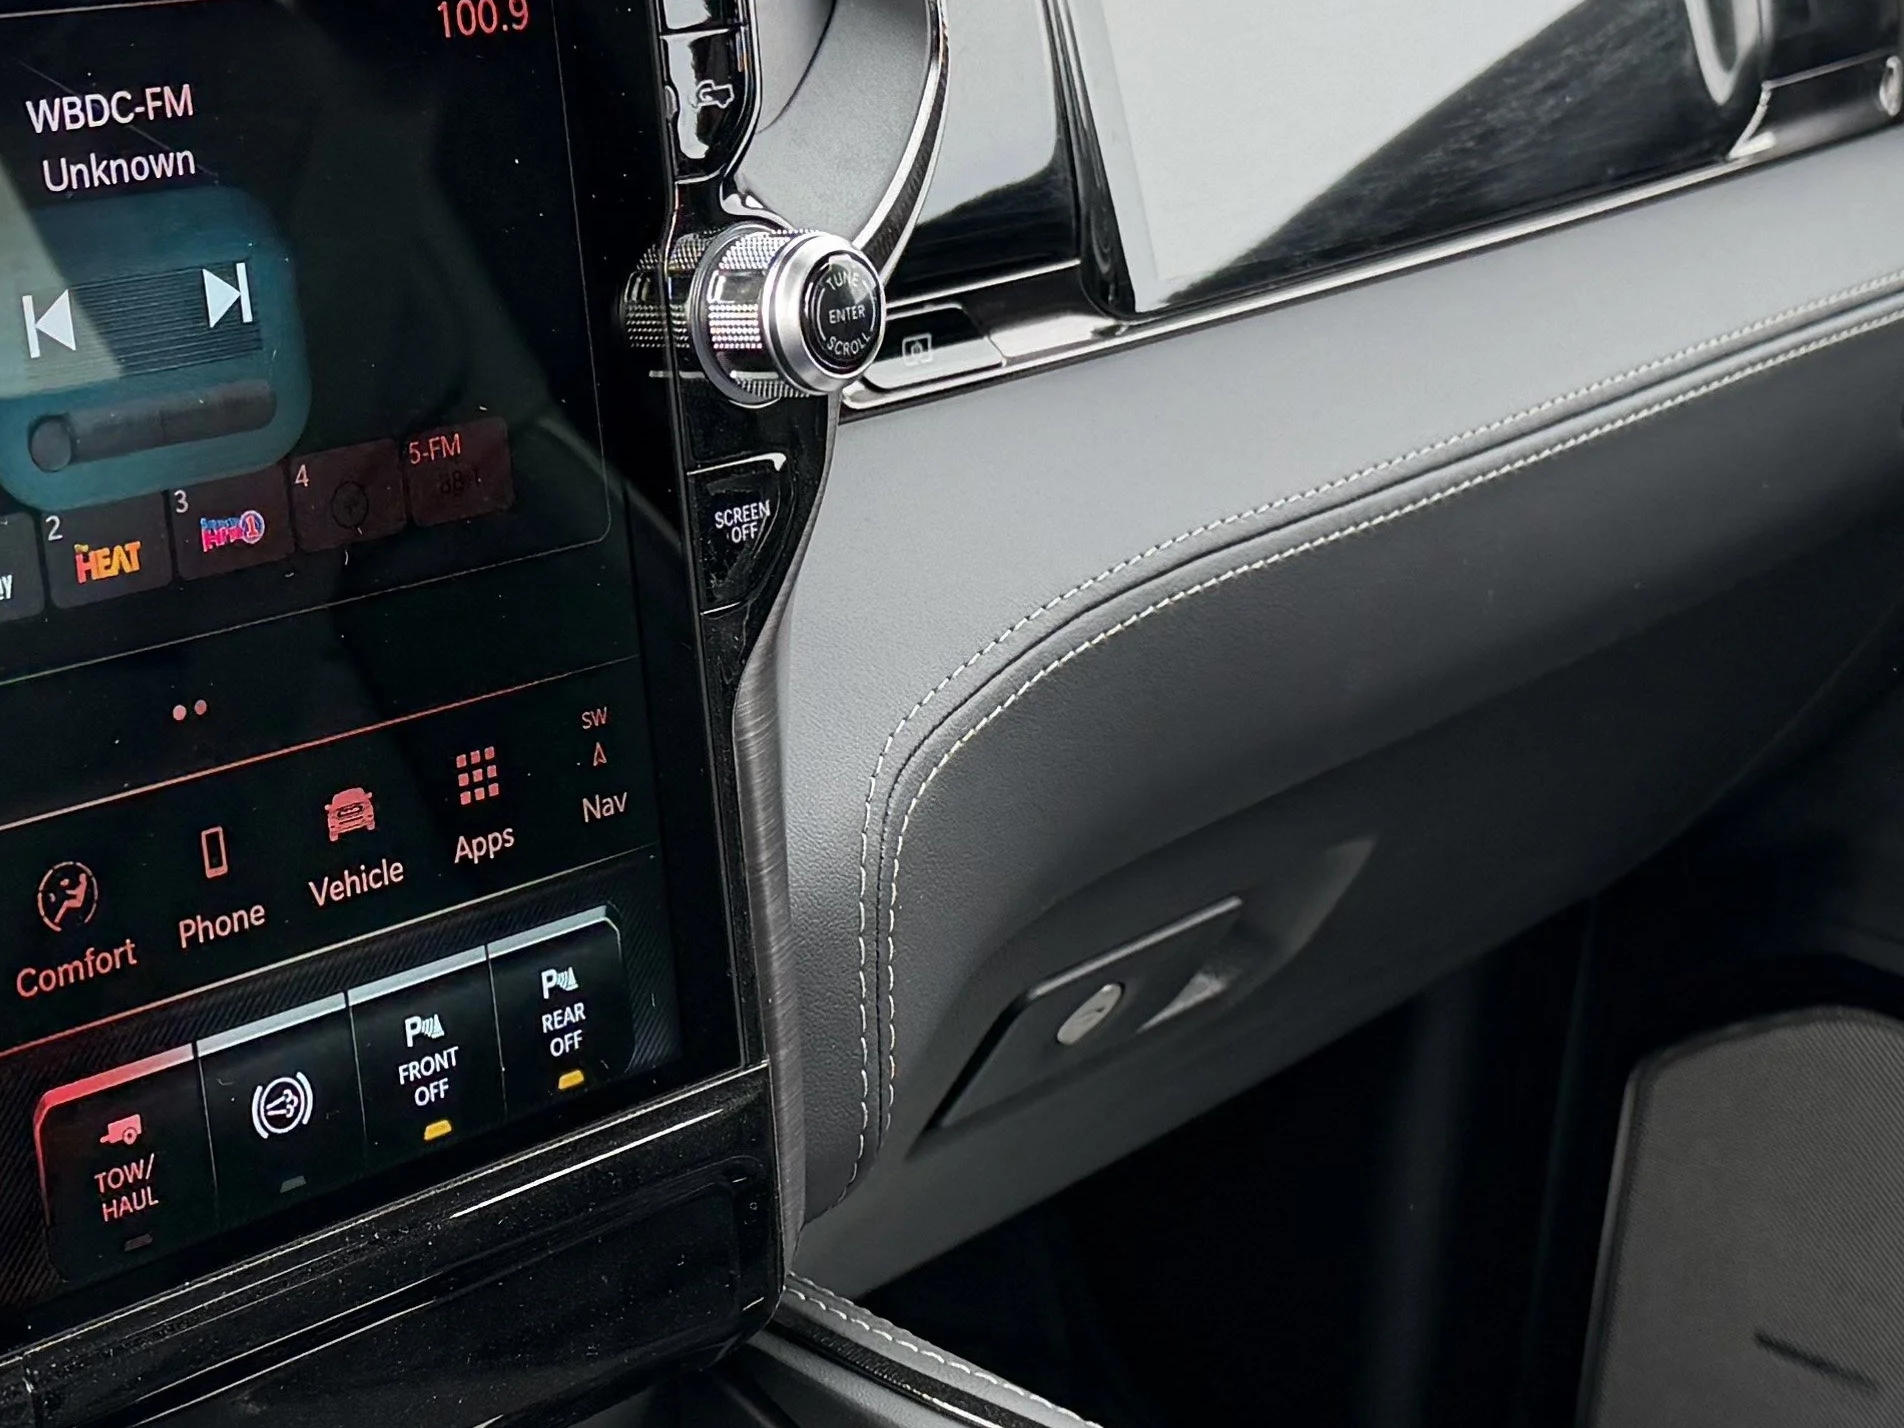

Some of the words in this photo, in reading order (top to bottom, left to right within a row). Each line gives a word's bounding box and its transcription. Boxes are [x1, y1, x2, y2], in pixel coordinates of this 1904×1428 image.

[25, 83, 195, 135] WBDC-FM
[41, 148, 197, 193] Unknown
[826, 272, 861, 291] TUNE
[828, 305, 867, 325] ENTER
[826, 332, 873, 359] SCROLL
[407, 432, 463, 465] 5-FM
[294, 464, 310, 487] 4
[174, 489, 190, 514] 3
[714, 499, 772, 529] SCREEN
[45, 515, 64, 542] 2
[731, 523, 759, 545] OFF
[75, 540, 143, 584] HEAT
[581, 708, 609, 730] SW
[582, 791, 629, 823] Nav
[454, 826, 515, 865] Apps
[308, 859, 405, 908] Vehicle
[178, 904, 266, 950] Phone
[15, 938, 138, 999] Comfort
[541, 1001, 587, 1034] REAR
[549, 1028, 584, 1058] OFF
[397, 1046, 459, 1086] FRONT
[413, 1078, 450, 1108] OFF
[93, 1153, 156, 1194] TOW/
[100, 1186, 160, 1224] HAUL
